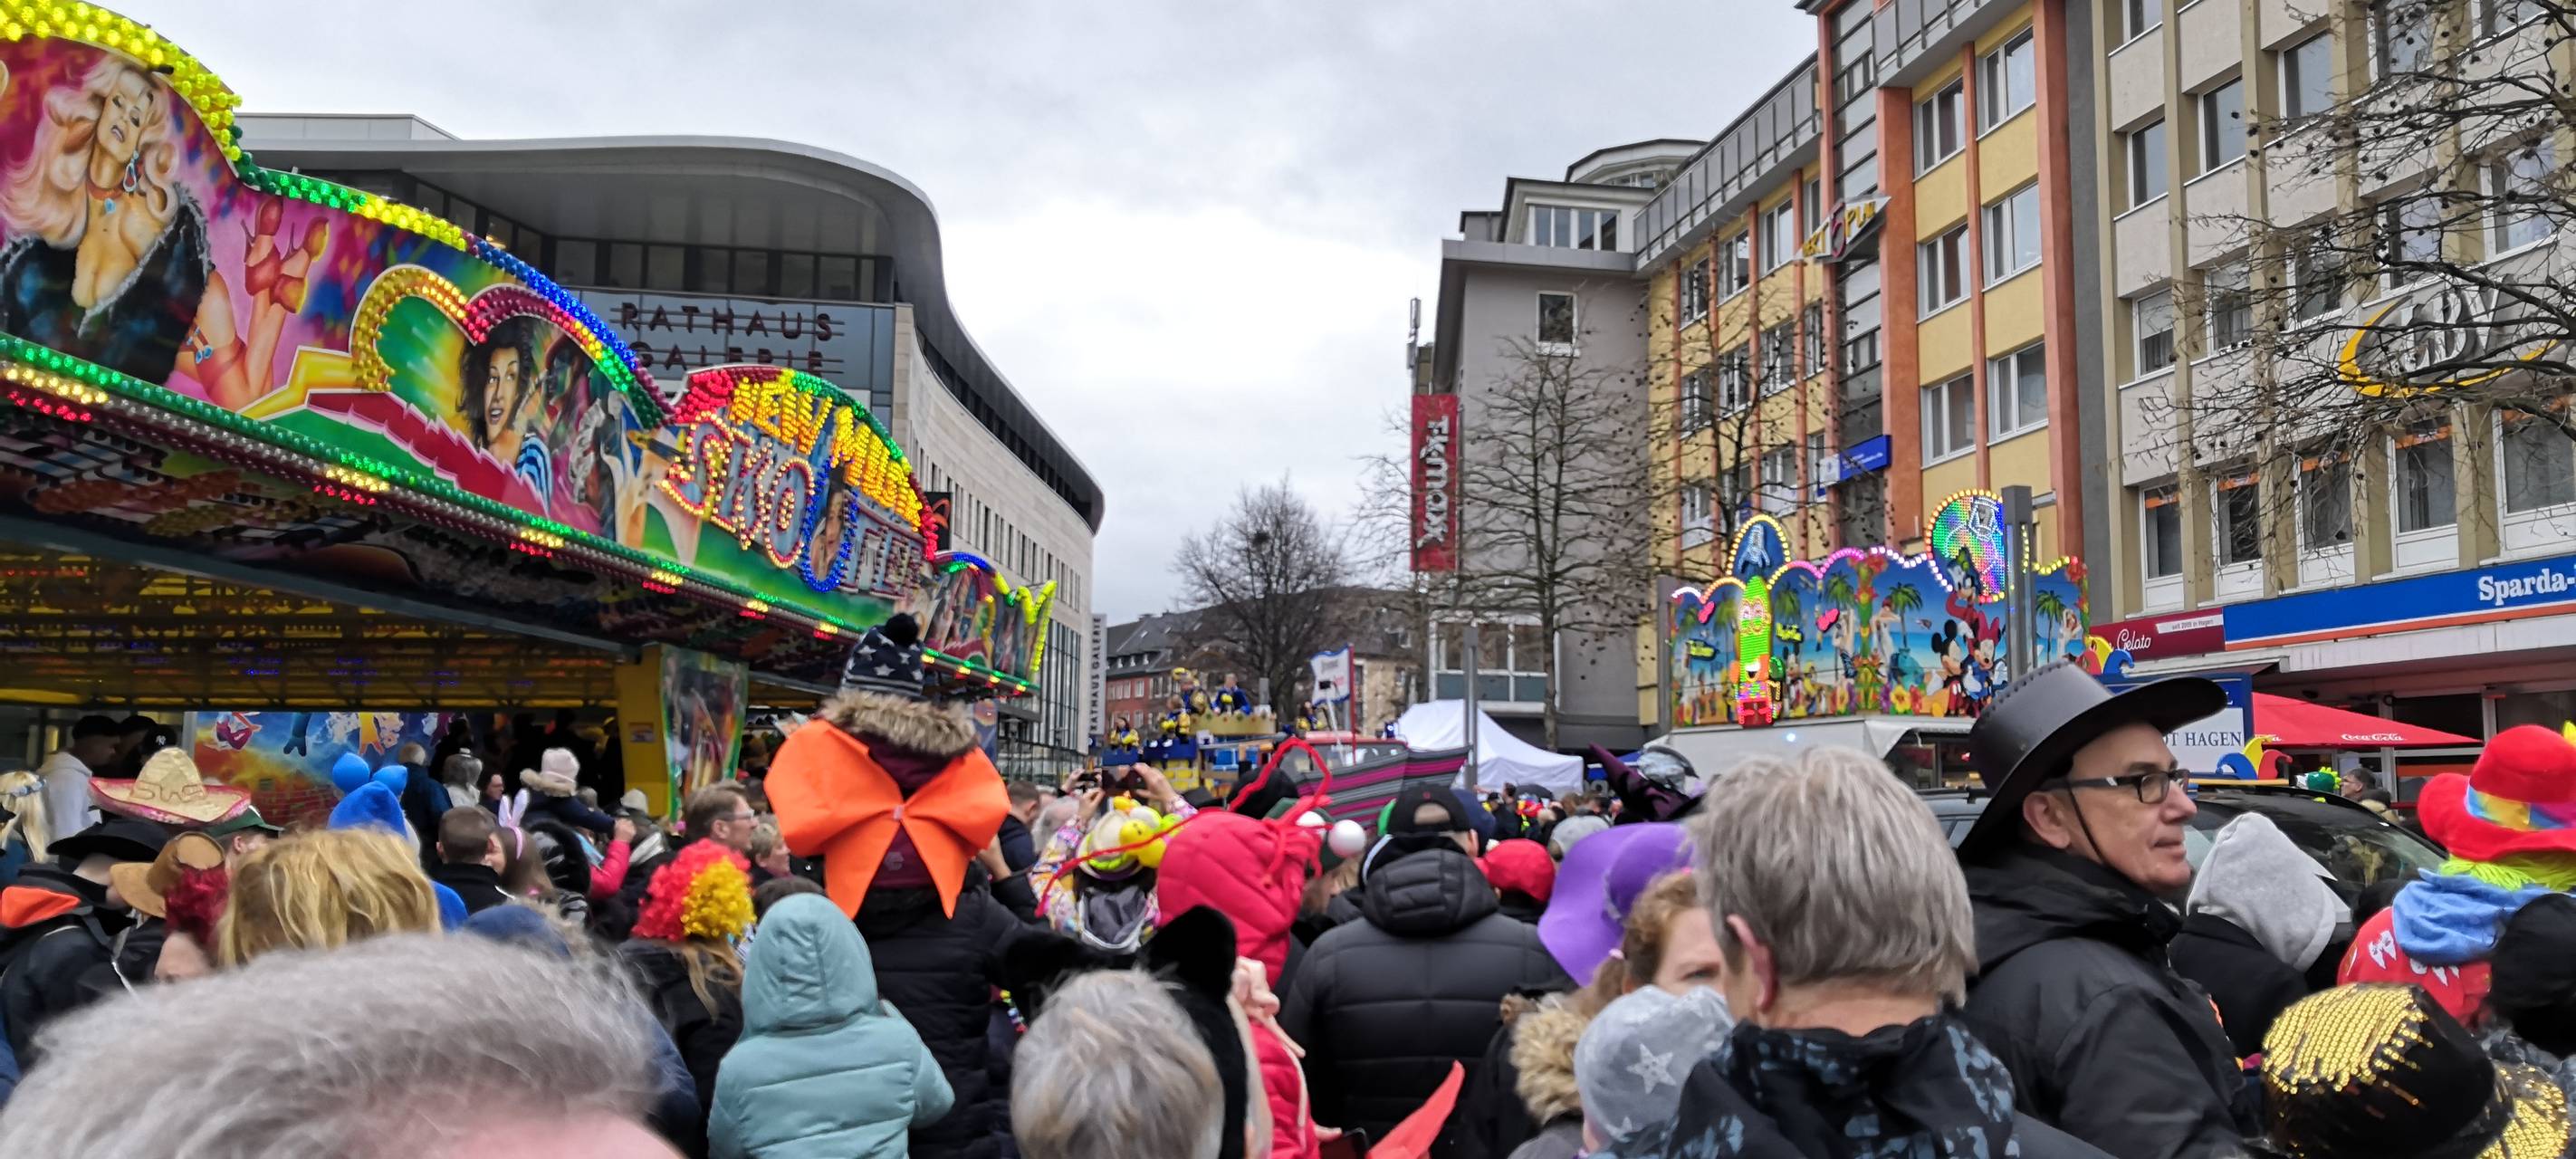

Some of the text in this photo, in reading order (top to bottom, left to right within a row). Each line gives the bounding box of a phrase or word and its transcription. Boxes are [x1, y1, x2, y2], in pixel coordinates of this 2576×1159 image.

[621, 302, 832, 341] RATHAUS
[629, 340, 823, 378] GALERIE
[729, 376, 833, 455] NEW
[2478, 564, 2576, 607] Sparda-
[2117, 628, 2151, 651] Gelato
[1089, 617, 1102, 732] RATHAUS GALERIE
[2185, 731, 2243, 747] HAGEN
